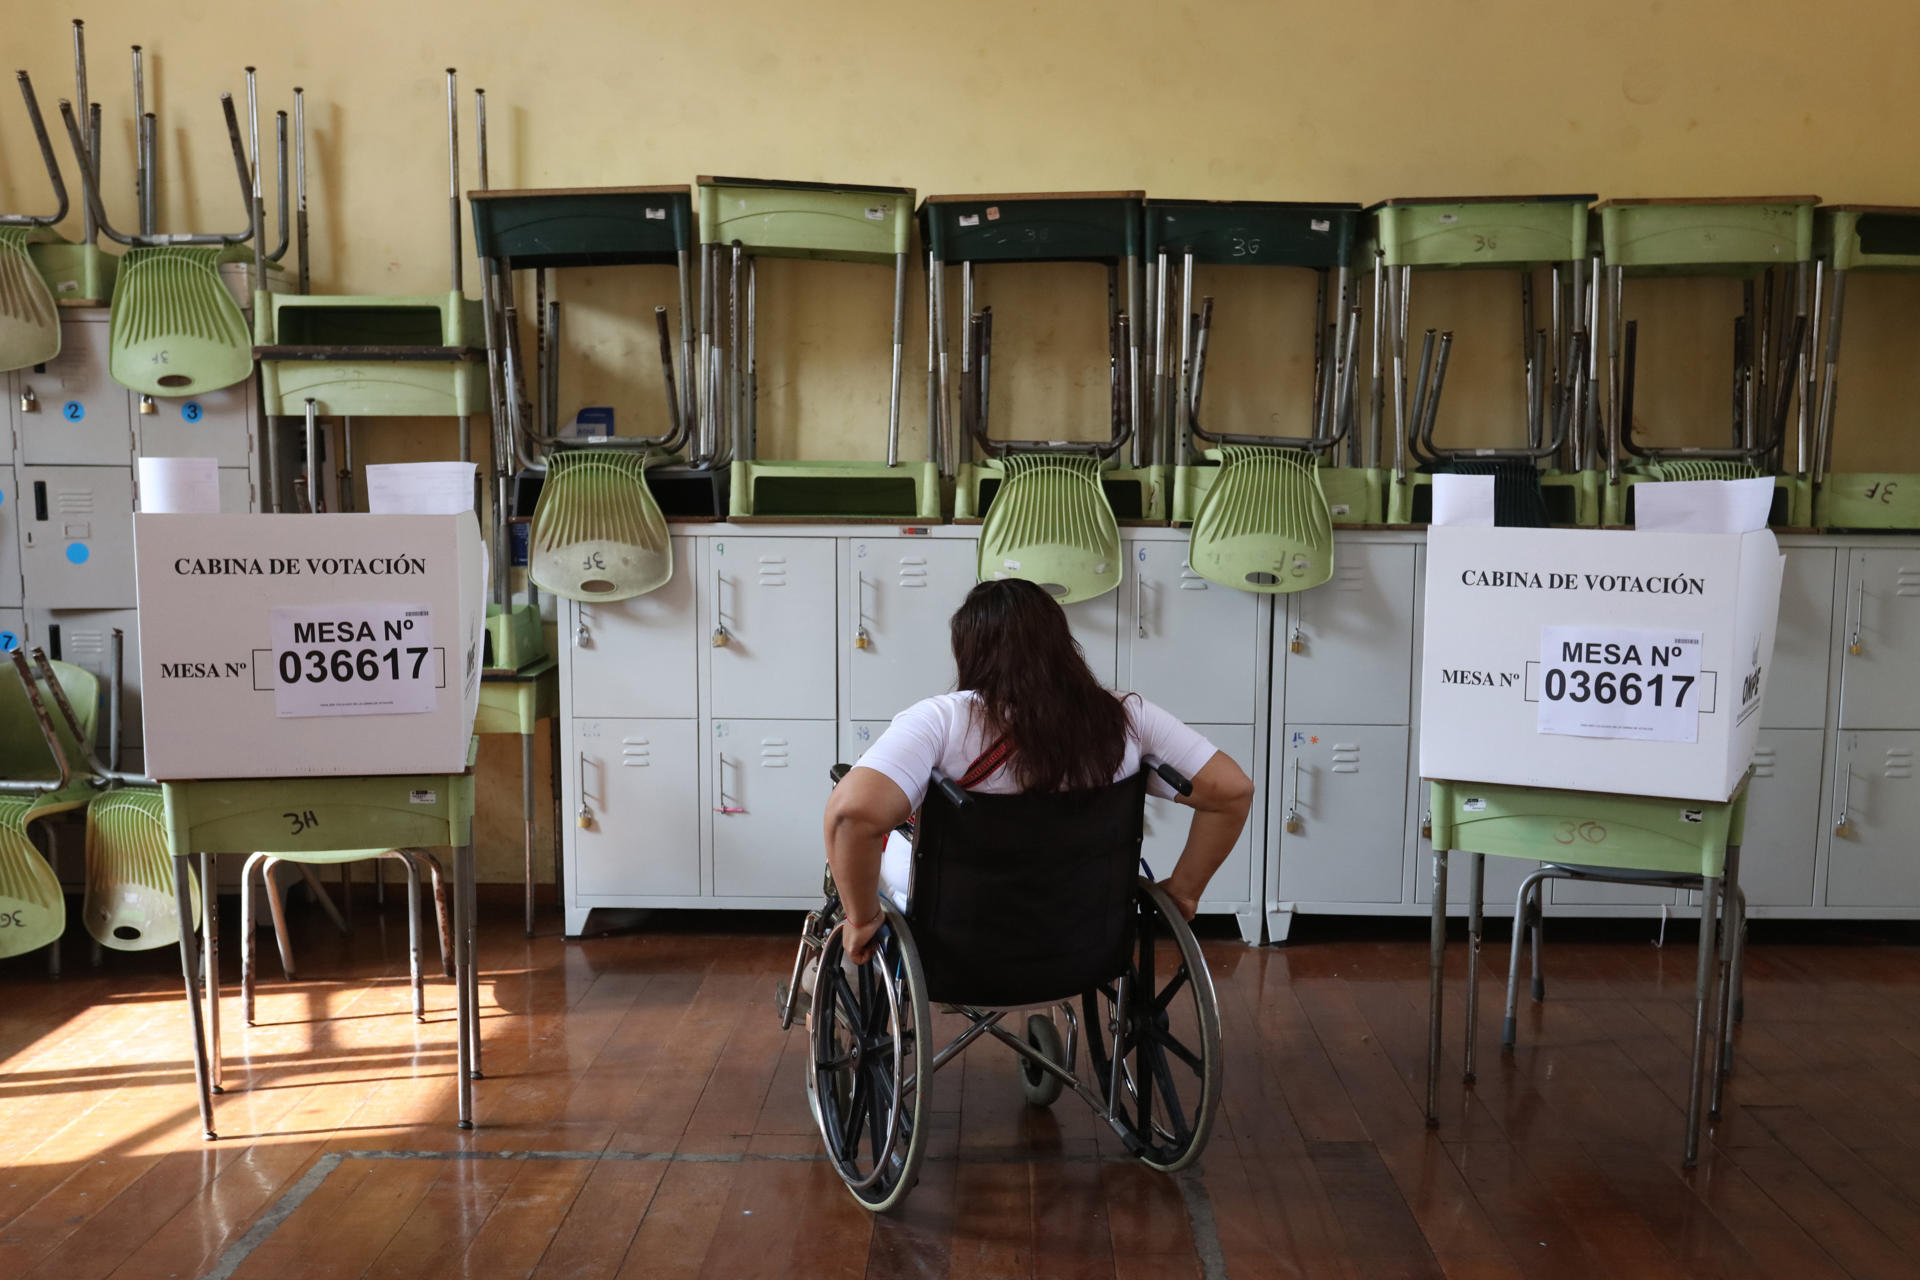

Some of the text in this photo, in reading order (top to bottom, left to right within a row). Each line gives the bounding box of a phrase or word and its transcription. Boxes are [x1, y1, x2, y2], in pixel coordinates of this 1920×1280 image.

[68, 403, 80, 419] 2
[187, 404, 198, 420] 3
[1864, 481, 1898, 504] 3F
[174, 553, 426, 575] CABINA DE VOTACIÓN
[583, 551, 606, 570] 3F
[1138, 547, 1146, 562] 6
[1461, 570, 1705, 595] CABINA DE VOTACIÓN
[3, 634, 13, 649] 7
[294, 621, 377, 644] MESA
[1562, 641, 1643, 666] MESA
[160, 662, 221, 679] MESA
[279, 646, 429, 684] 036617
[1441, 669, 1494, 687] MESA
[1545, 668, 1695, 708] 036617
[282, 810, 319, 835] 3H
